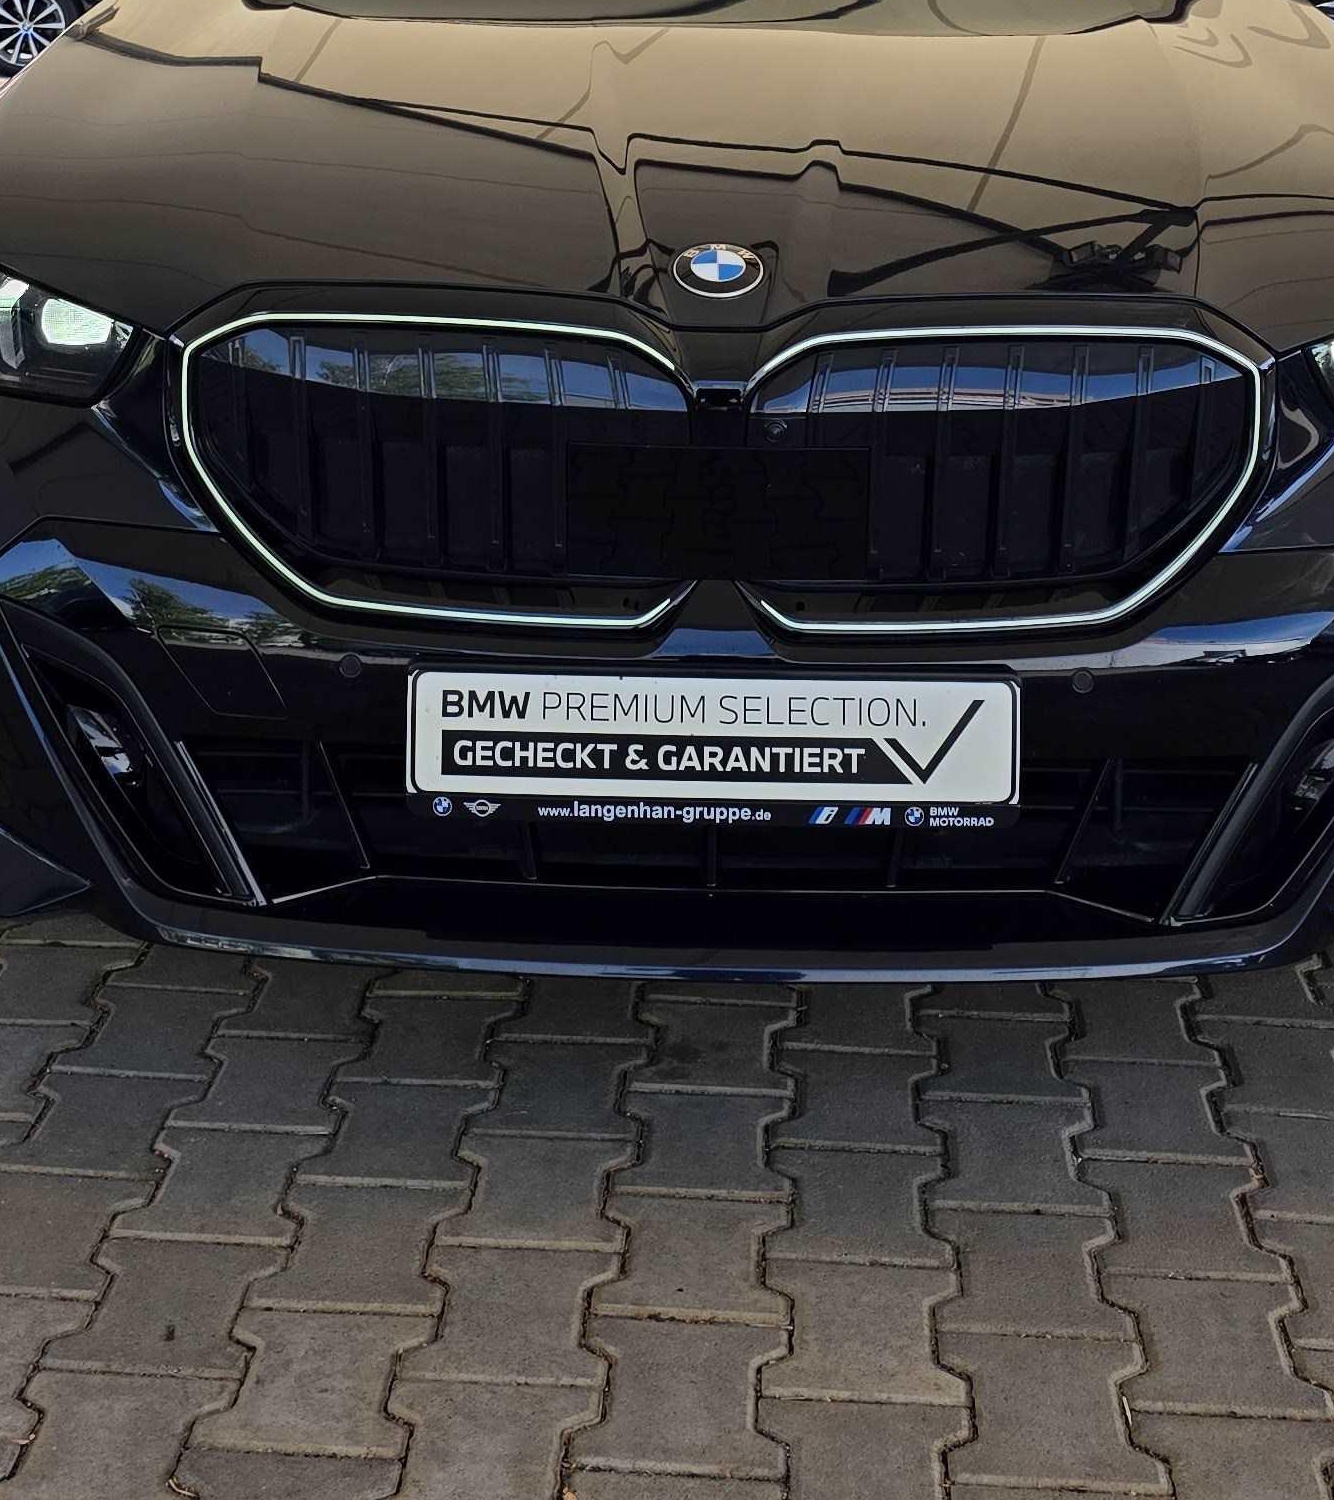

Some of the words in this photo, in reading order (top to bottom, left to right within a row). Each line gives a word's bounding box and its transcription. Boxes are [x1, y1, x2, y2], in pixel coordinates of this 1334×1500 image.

[683, 243, 756, 259] BMW
[441, 689, 531, 719] BMW
[542, 691, 706, 724] PREMIUM
[719, 695, 926, 728] SELECTION.
[453, 739, 618, 770] GECHECKT
[624, 743, 651, 771] &
[657, 745, 866, 774] GARANTIERT
[537, 800, 772, 823] www.langenhan-gruppe.de
[929, 806, 959, 816] BMW
[929, 817, 995, 827] MOTORRAD
